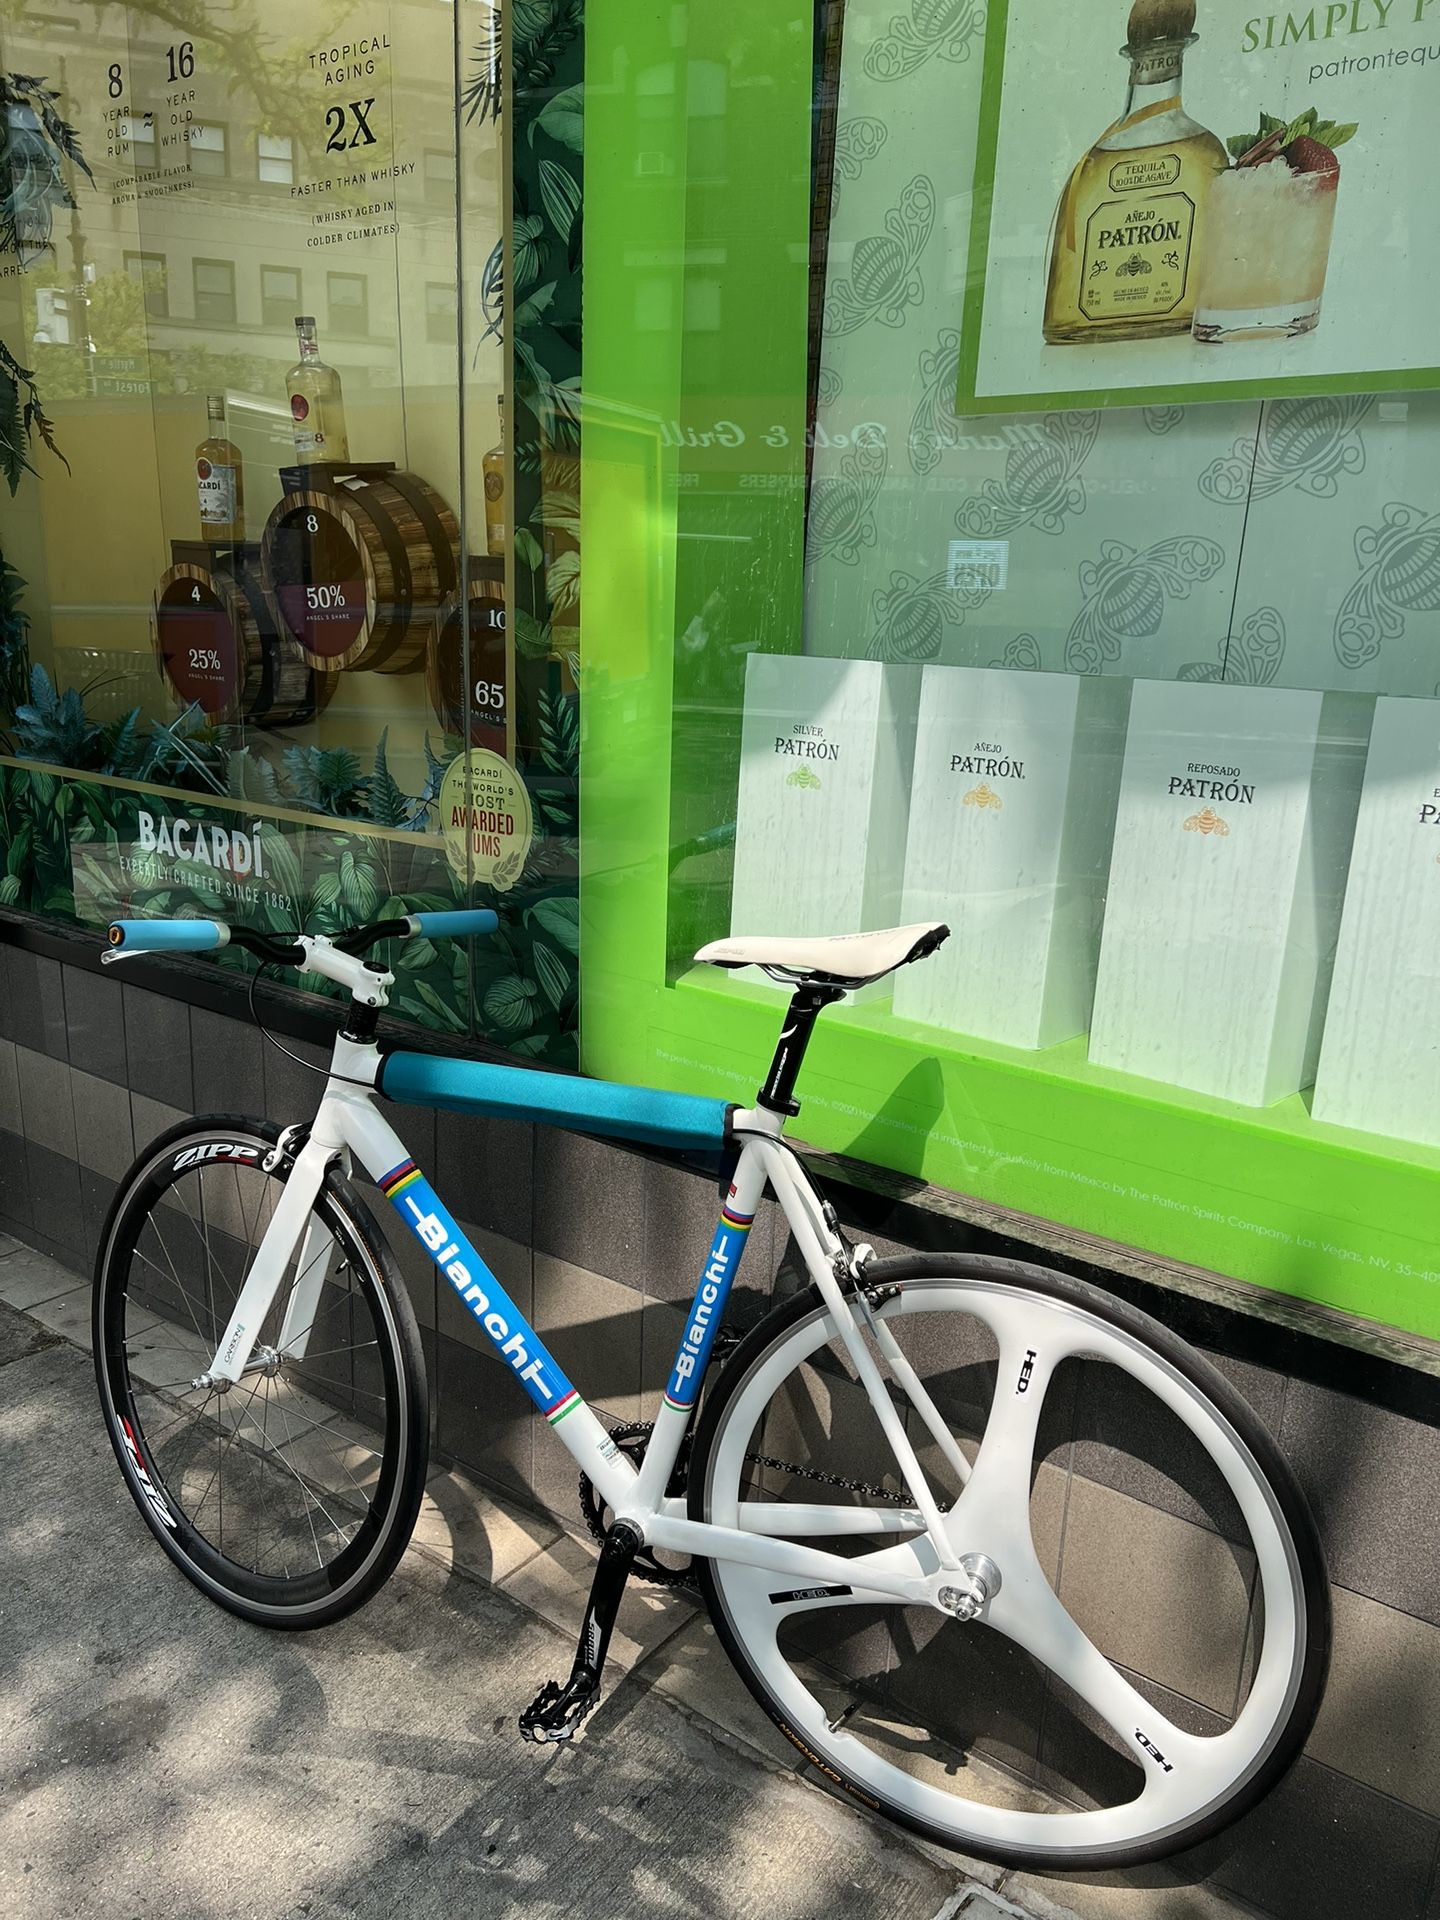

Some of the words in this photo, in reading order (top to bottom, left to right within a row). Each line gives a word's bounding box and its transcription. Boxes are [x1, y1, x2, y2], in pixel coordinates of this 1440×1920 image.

[1242, 0, 1394, 53] SIMPLY
[166, 42, 195, 83] 16
[309, 34, 390, 69] TROPICAL
[108, 63, 123, 98] 8
[325, 60, 375, 86] AGING
[166, 90, 196, 108] YEAR
[103, 106, 131, 122] YEAR
[171, 110, 193, 125] OLD
[107, 125, 128, 140] OLD
[161, 127, 204, 147] WHISKY
[325, 98, 377, 154] 2X
[107, 143, 129, 158] RUM
[1125, 161, 1166, 175] TEQUILA
[291, 180, 332, 197] FASTER
[337, 174, 366, 188] THAN
[371, 162, 415, 181] WHISKY
[355, 204, 381, 217] AGED
[383, 201, 394, 212] IN
[1125, 210, 1155, 223] AÑEJO
[307, 232, 343, 247] COLDER
[307, 514, 319, 533] 8
[191, 585, 201, 602] 4
[306, 584, 346, 609] 50%
[189, 648, 221, 670] 25%
[793, 724, 824, 737] SILVER
[774, 737, 840, 761] PATRÓN
[974, 742, 1002, 753] AÑEJO
[1187, 762, 1241, 777] REPOSADO
[473, 783, 514, 796] WORLD'S
[1168, 776, 1256, 804] PATRÓN
[138, 810, 264, 878] BACARDÍ
[119, 855, 168, 881] EXPERTLY
[174, 869, 221, 894] CRAFTED
[226, 882, 259, 904] SINCE
[265, 891, 292, 912] 1862
[172, 1143, 259, 1172] ZIPP
[940, 1135, 987, 1154] imported
[1043, 1162, 1069, 1177] from
[1070, 1170, 1110, 1190] Mexico
[1112, 1181, 1127, 1196] by
[1130, 1187, 1149, 1202] The
[1192, 1205, 1226, 1224] Spirits
[1297, 1233, 1316, 1249] Las
[405, 1196, 552, 1399] Bianchi
[674, 1235, 729, 1393] Bianchi
